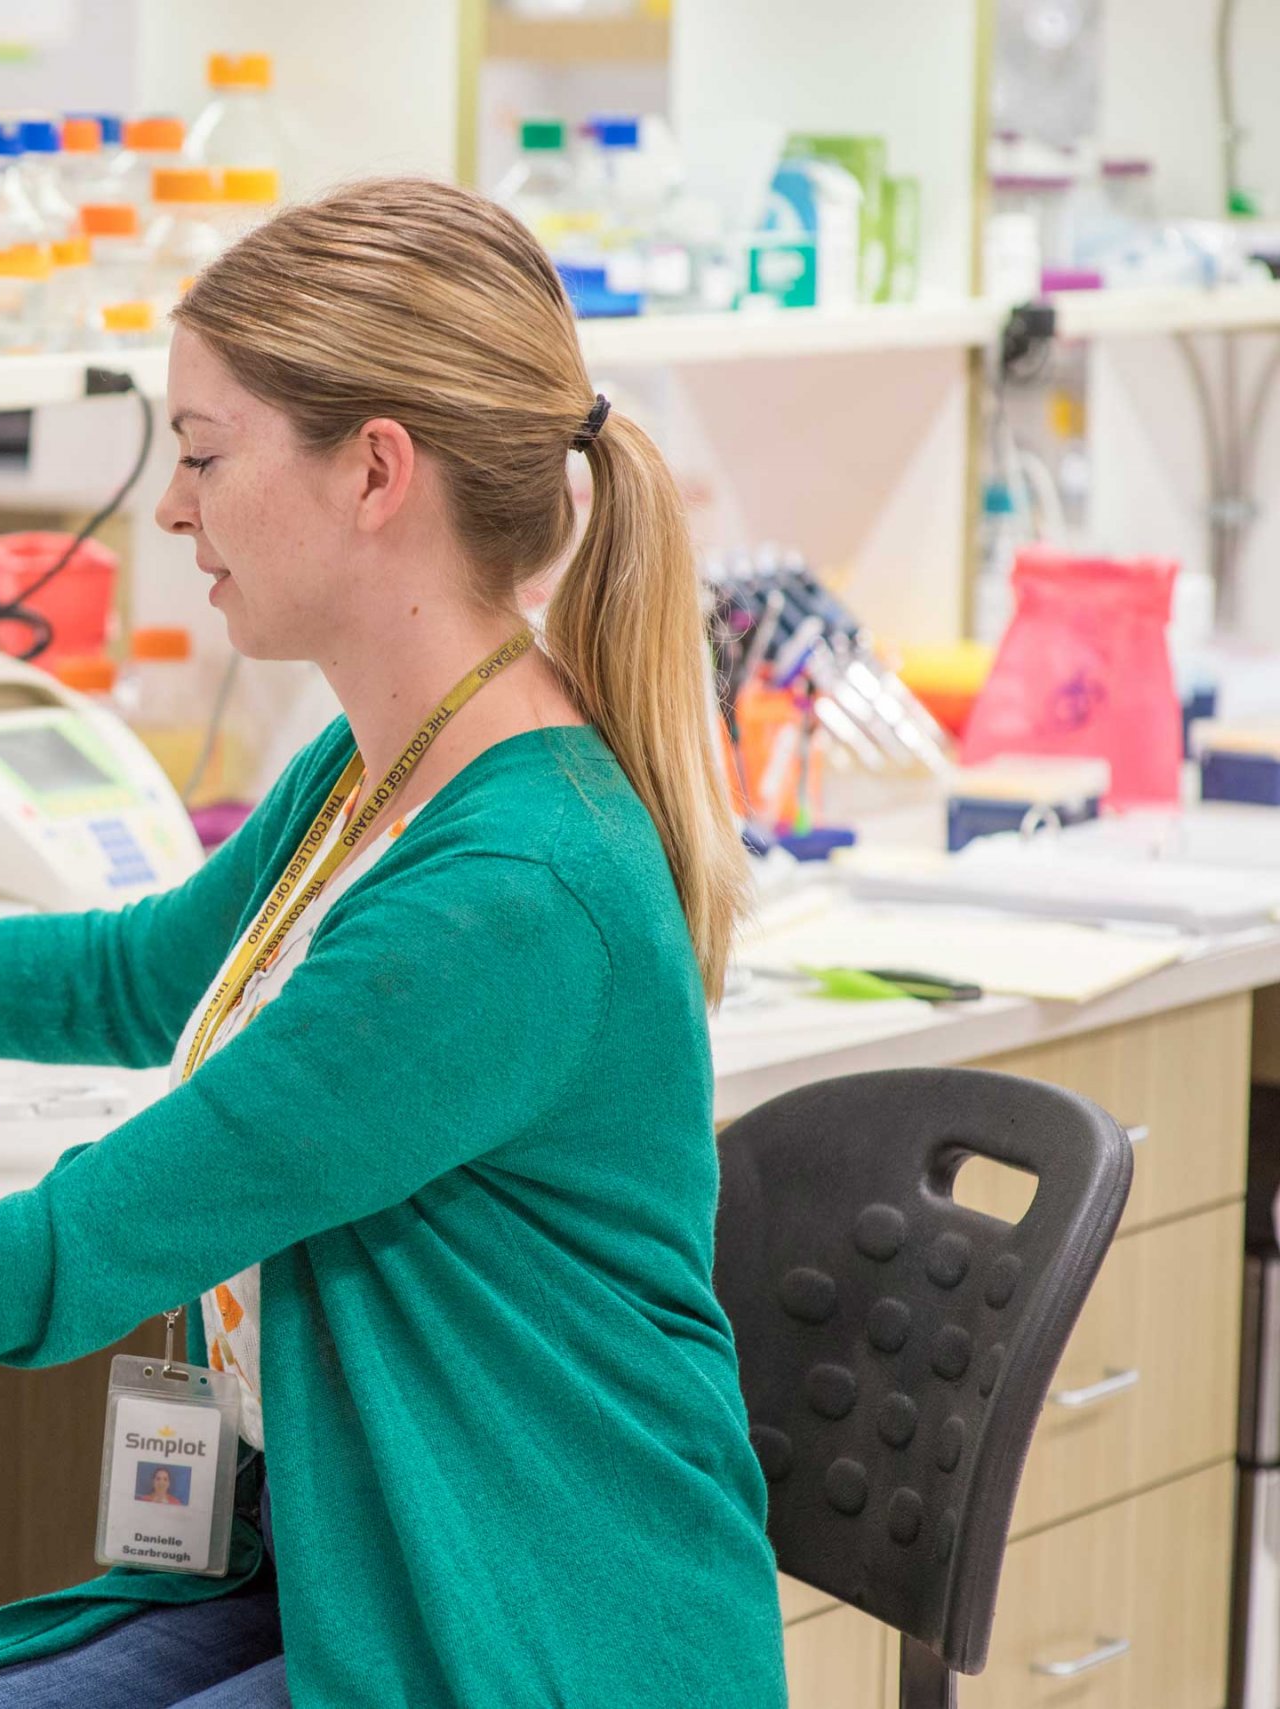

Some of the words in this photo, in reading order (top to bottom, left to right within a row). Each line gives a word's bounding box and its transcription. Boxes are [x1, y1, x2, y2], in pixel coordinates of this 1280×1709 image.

[477, 647, 514, 679] IDAHO
[427, 706, 453, 734] THE
[384, 731, 430, 791] COLLEGE
[322, 793, 345, 821] THE
[373, 788, 390, 809] OF
[343, 805, 378, 847] IDAHO
[284, 822, 327, 880] COLLEGE
[275, 882, 290, 902] OF
[302, 879, 326, 901] THE
[248, 903, 279, 945] IDAHO
[262, 903, 306, 955] COLLEGE
[210, 982, 229, 1005] THE
[125, 1432, 207, 1458] Simplot
[122, 1545, 191, 1562] Scarbrough
[134, 1532, 183, 1547] Danielle
